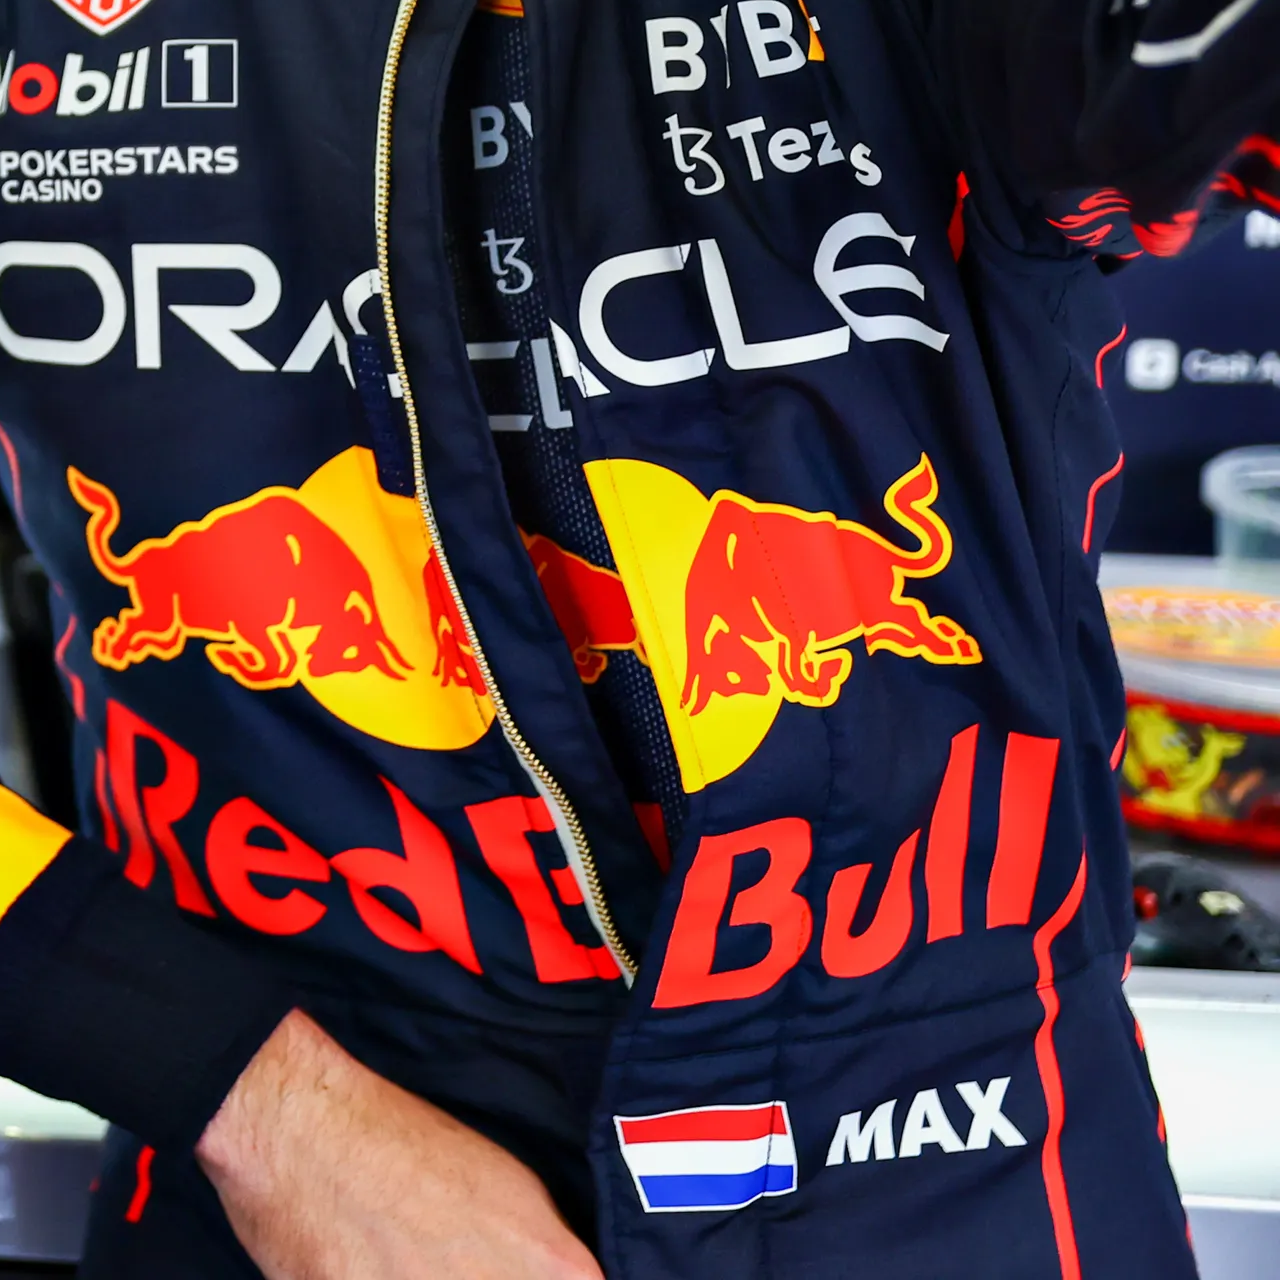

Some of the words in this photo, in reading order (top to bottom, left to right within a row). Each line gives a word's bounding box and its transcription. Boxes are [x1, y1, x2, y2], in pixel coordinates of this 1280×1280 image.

[0, 145, 238, 179] POKERSTARS
[1, 177, 103, 202] CASINO
[726, 115, 883, 186] Tezs
[106, 700, 482, 974] Red
[652, 724, 1059, 1009] Bull
[826, 1077, 1028, 1168] MAX
